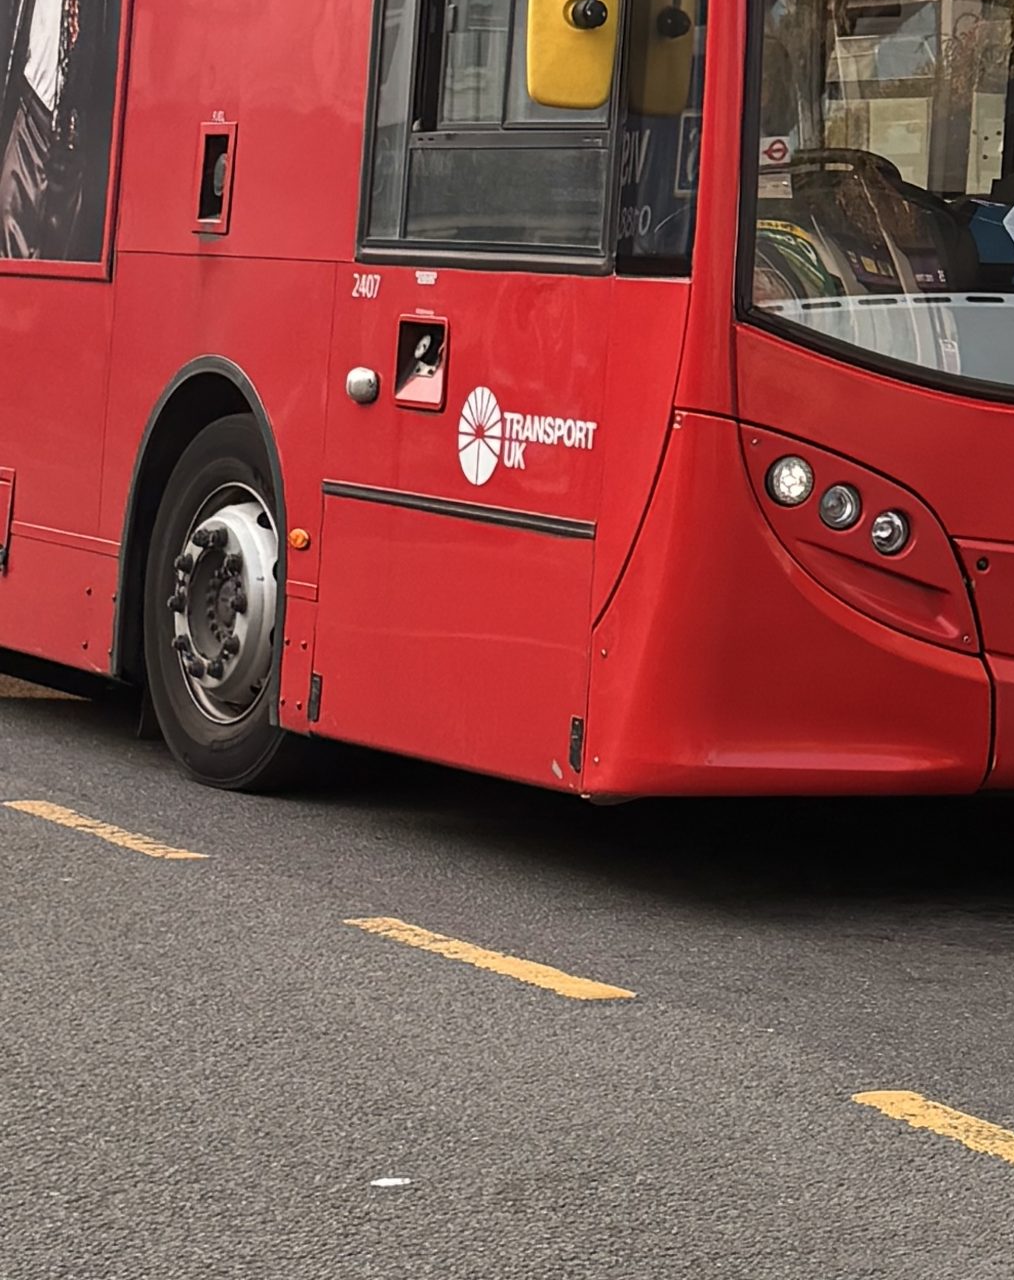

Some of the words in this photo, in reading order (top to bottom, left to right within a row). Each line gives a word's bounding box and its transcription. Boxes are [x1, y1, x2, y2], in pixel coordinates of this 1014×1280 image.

[352, 273, 381, 298] 2407
[504, 412, 597, 450] TRANSPORT
[504, 442, 526, 470] UK
